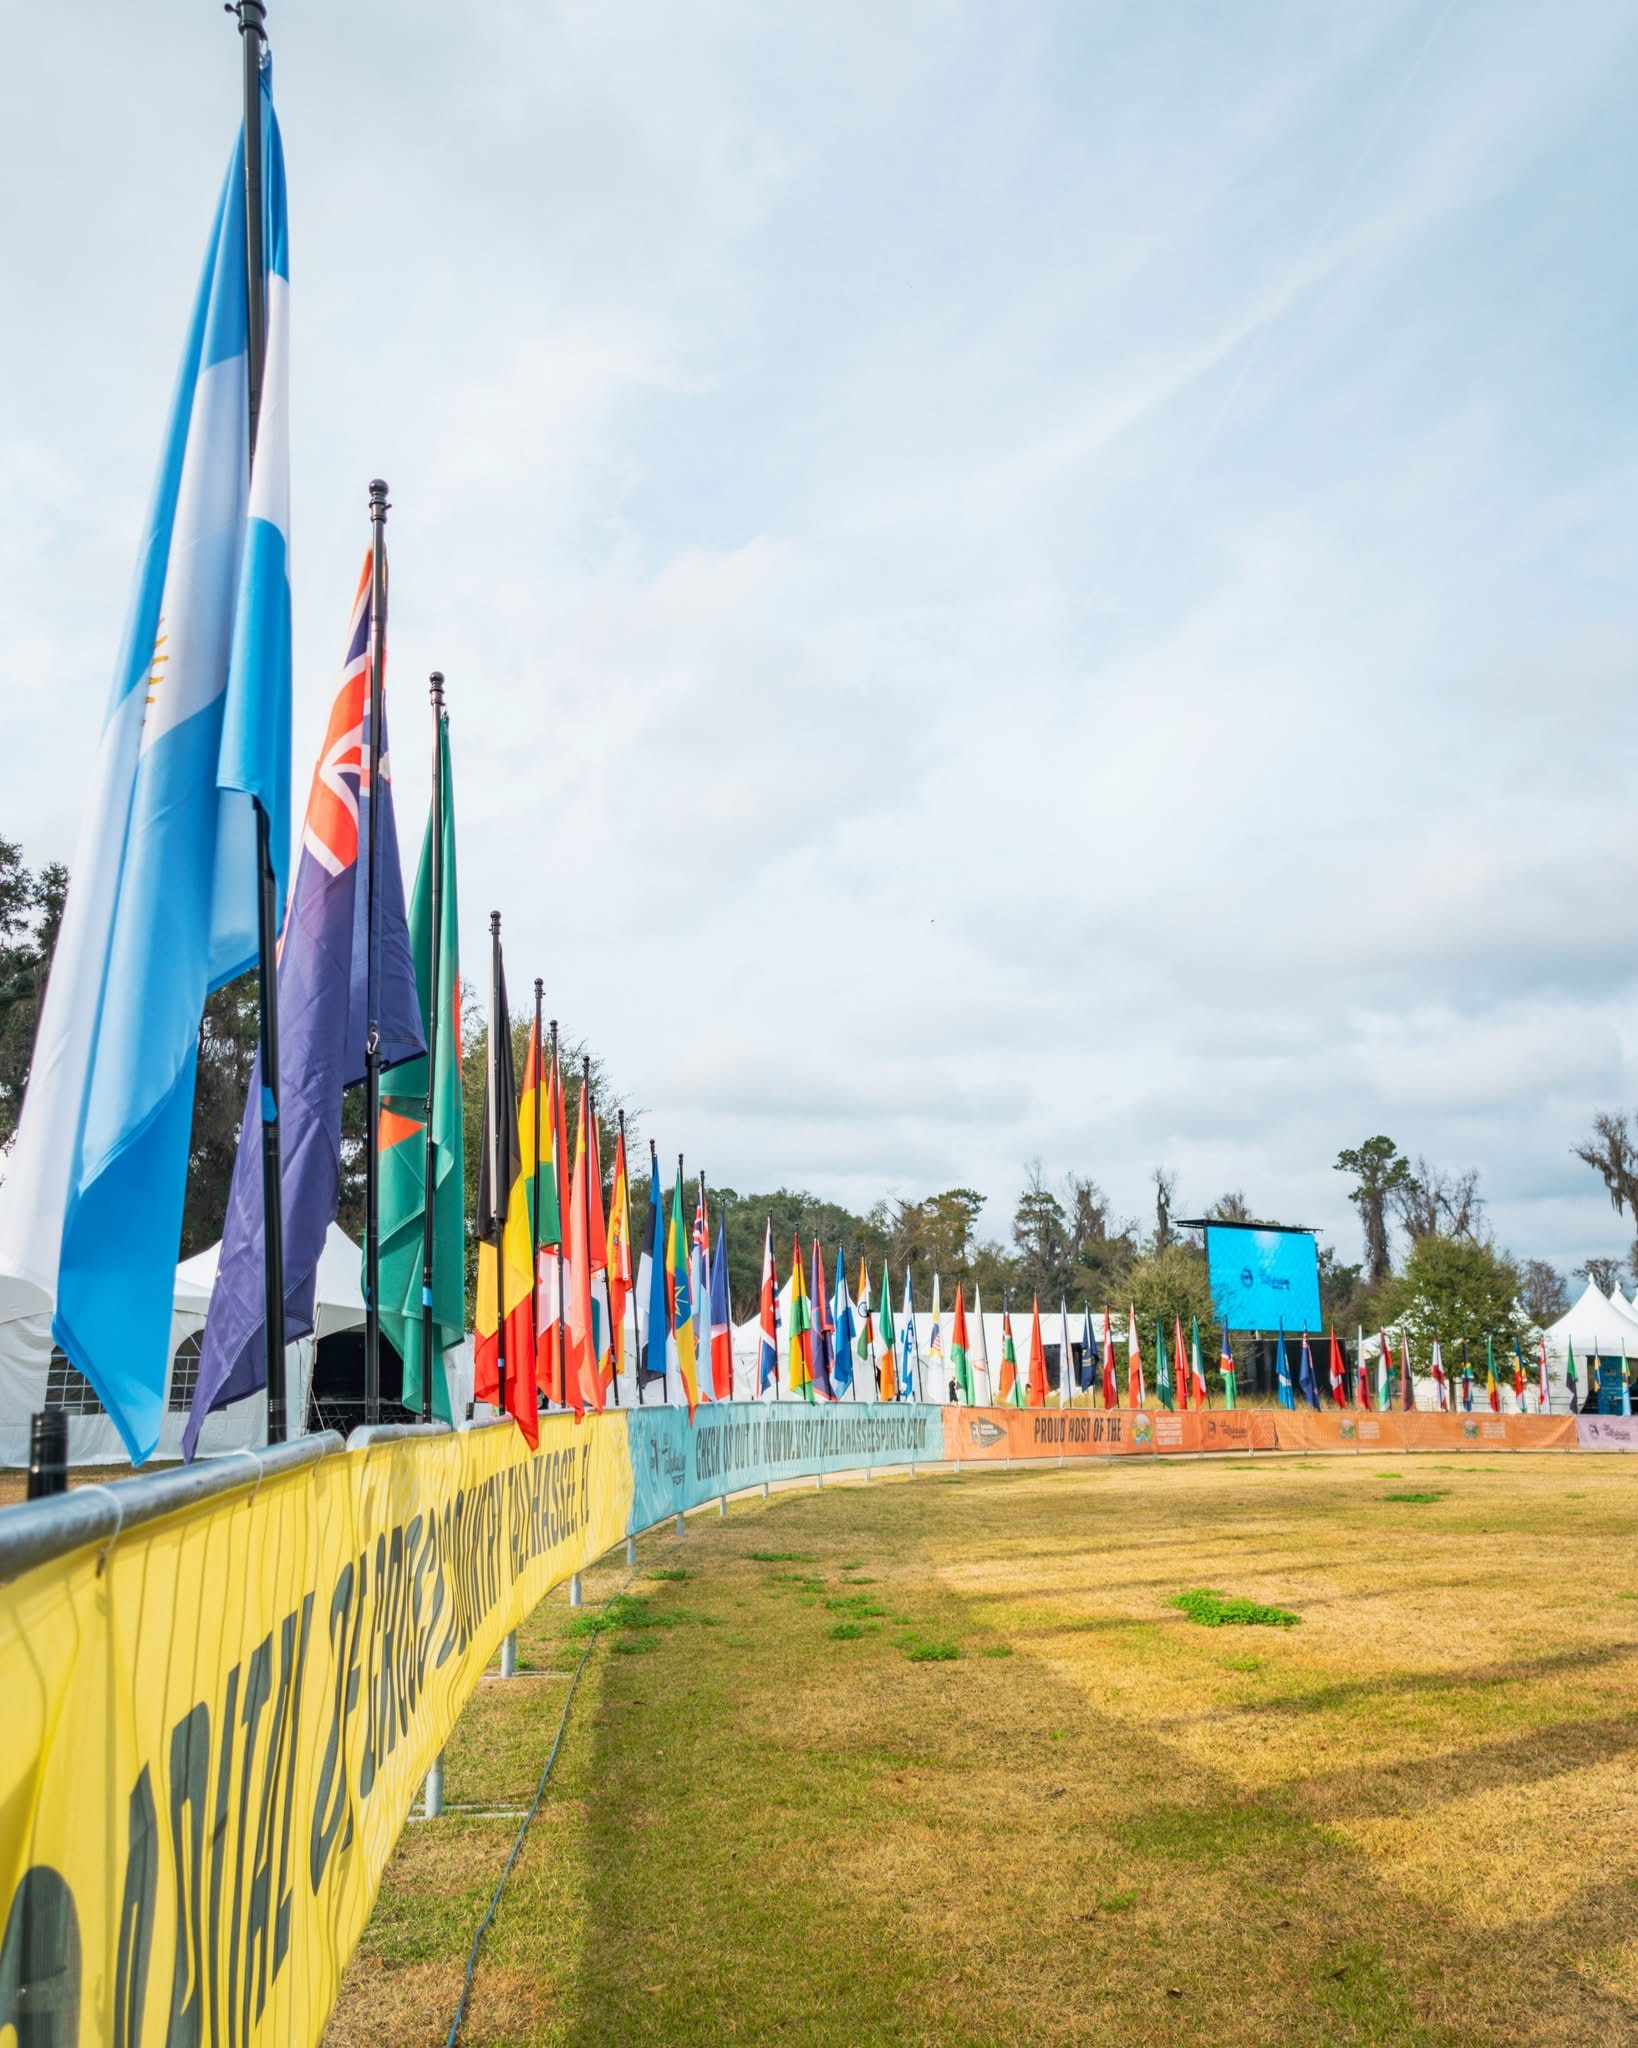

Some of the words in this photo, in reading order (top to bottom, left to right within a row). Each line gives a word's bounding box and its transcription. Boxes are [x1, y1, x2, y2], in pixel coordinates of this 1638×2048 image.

[696, 1426, 721, 1481] CHECK
[723, 1424, 733, 1473] US
[735, 1423, 750, 1470] OUT
[753, 1421, 761, 1466] AT
[1034, 1417, 1066, 1443] PROUD
[1068, 1417, 1090, 1442] HOST
[1093, 1417, 1104, 1442] OF
[1106, 1417, 1121, 1441] THE
[0, 1590, 316, 2048] PITAL
[310, 1552, 368, 1897] OF
[508, 1446, 578, 1586] TALLHASSEE,
[580, 1443, 592, 1527] FL
